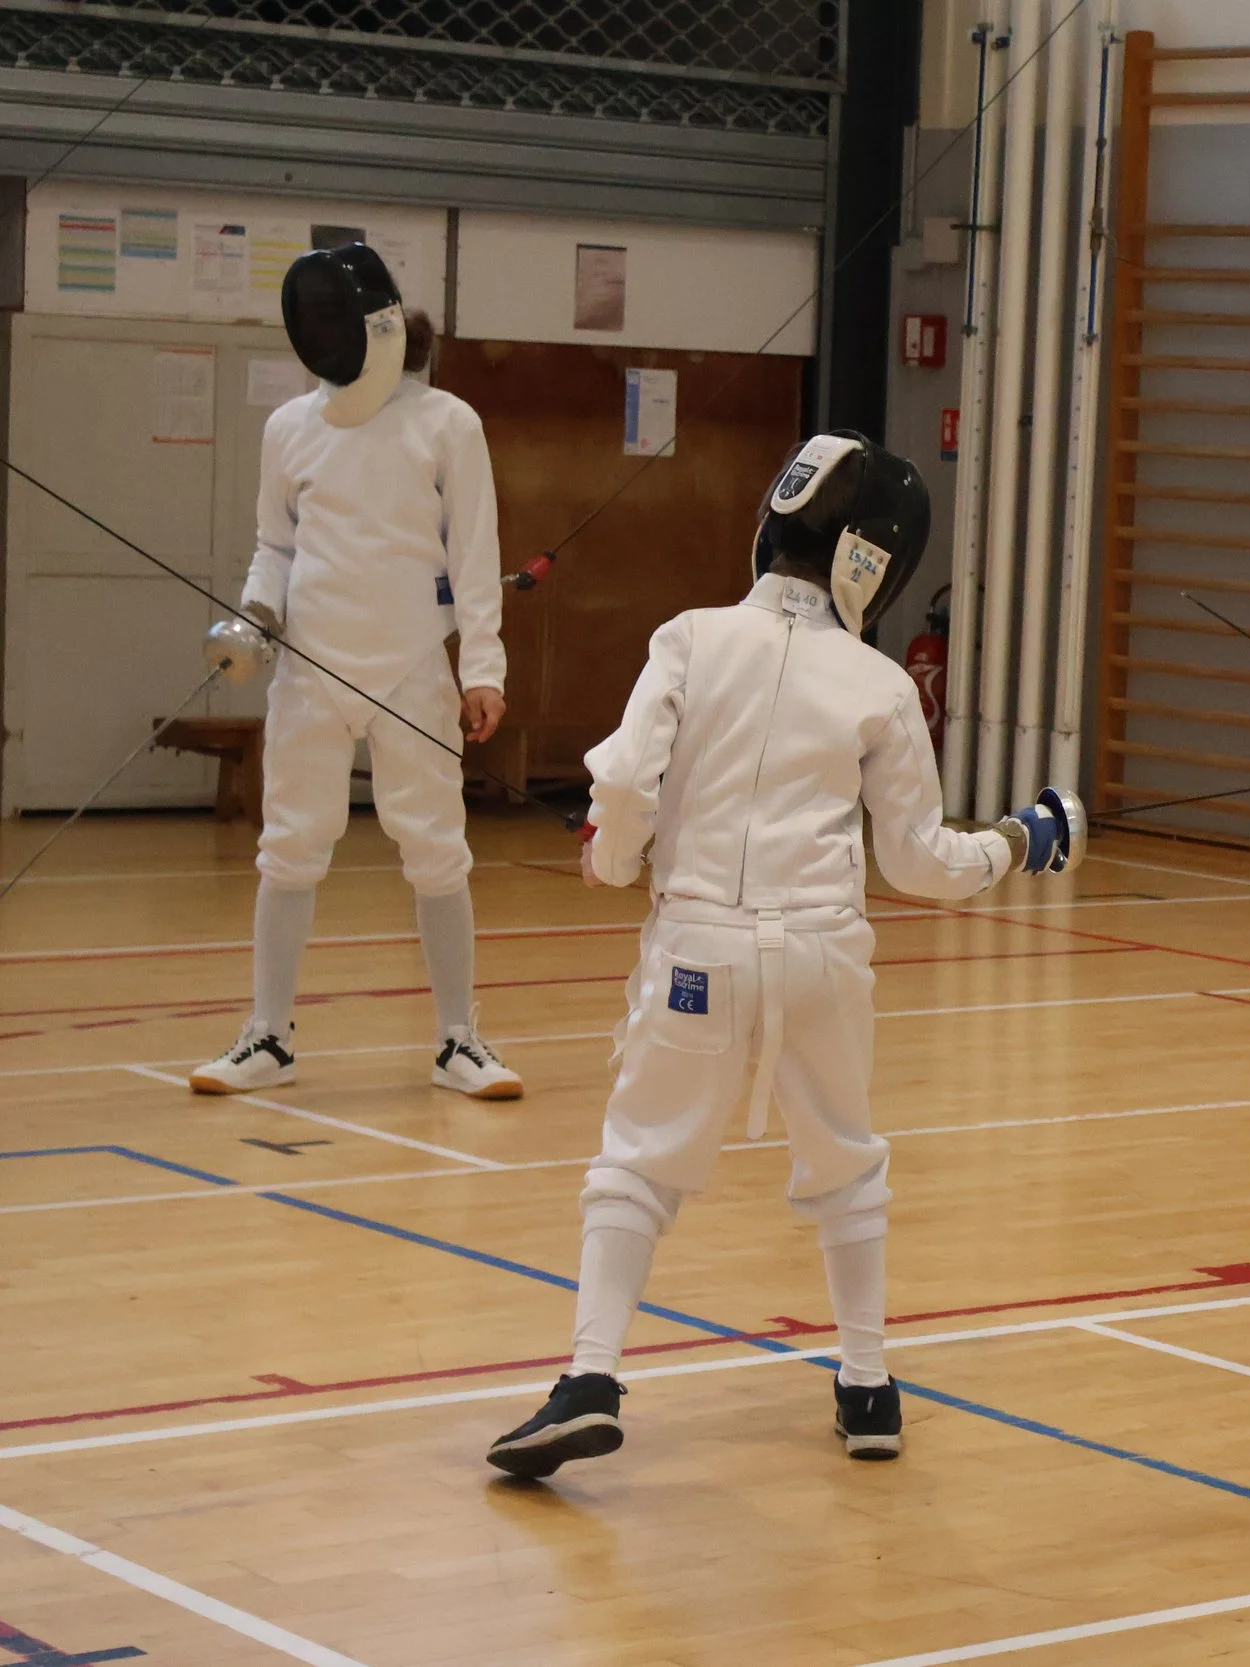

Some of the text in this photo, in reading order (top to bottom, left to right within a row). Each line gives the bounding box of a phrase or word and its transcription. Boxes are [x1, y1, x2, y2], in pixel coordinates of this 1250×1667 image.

[674, 968, 696, 983] Royal
[675, 977, 704, 991] Escrime
[679, 998, 694, 1010] CE
